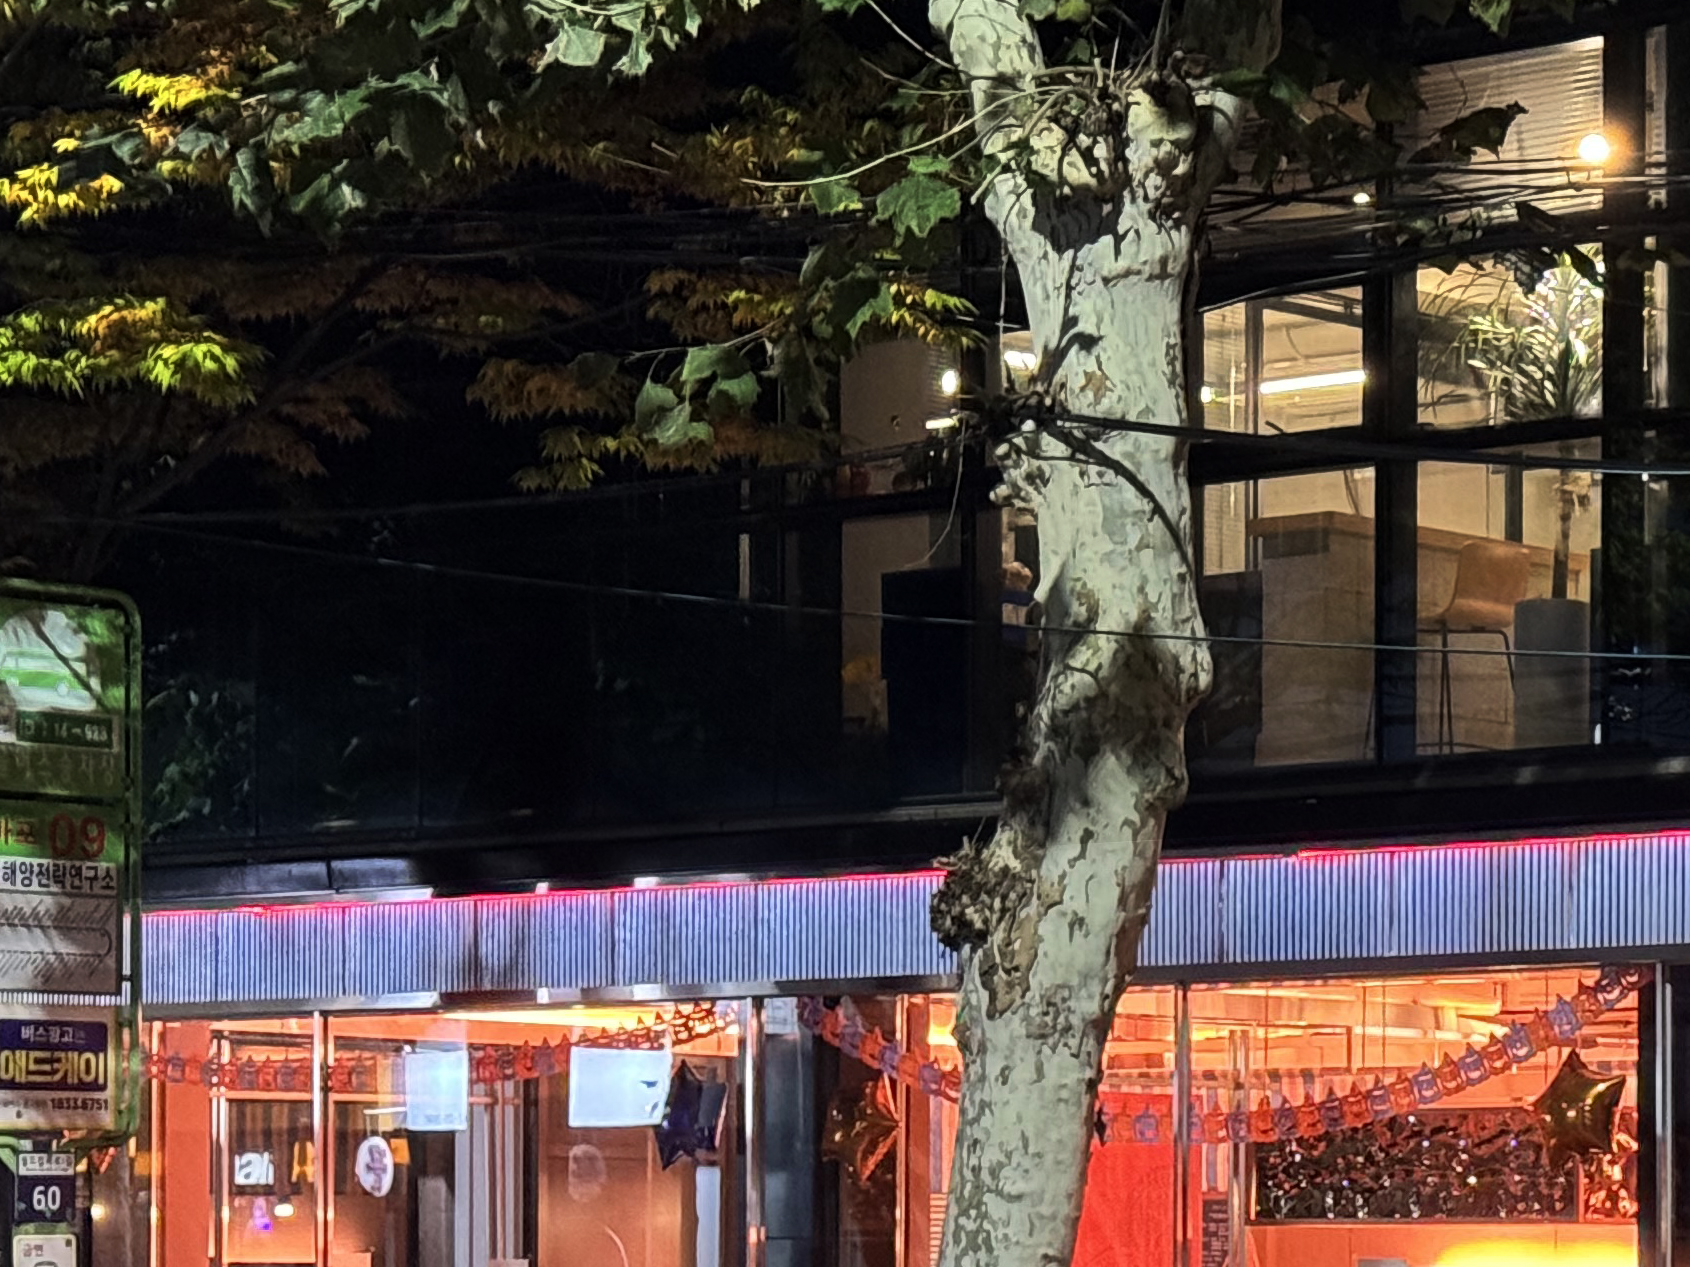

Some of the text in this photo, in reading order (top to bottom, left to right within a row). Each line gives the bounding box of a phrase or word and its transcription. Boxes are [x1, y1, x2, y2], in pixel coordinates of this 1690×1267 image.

[51, 812, 106, 859] 09
[2, 861, 116, 891] 해양전략연구소
[1, 1050, 105, 1085] 애드케이
[32, 1185, 61, 1212] 60
